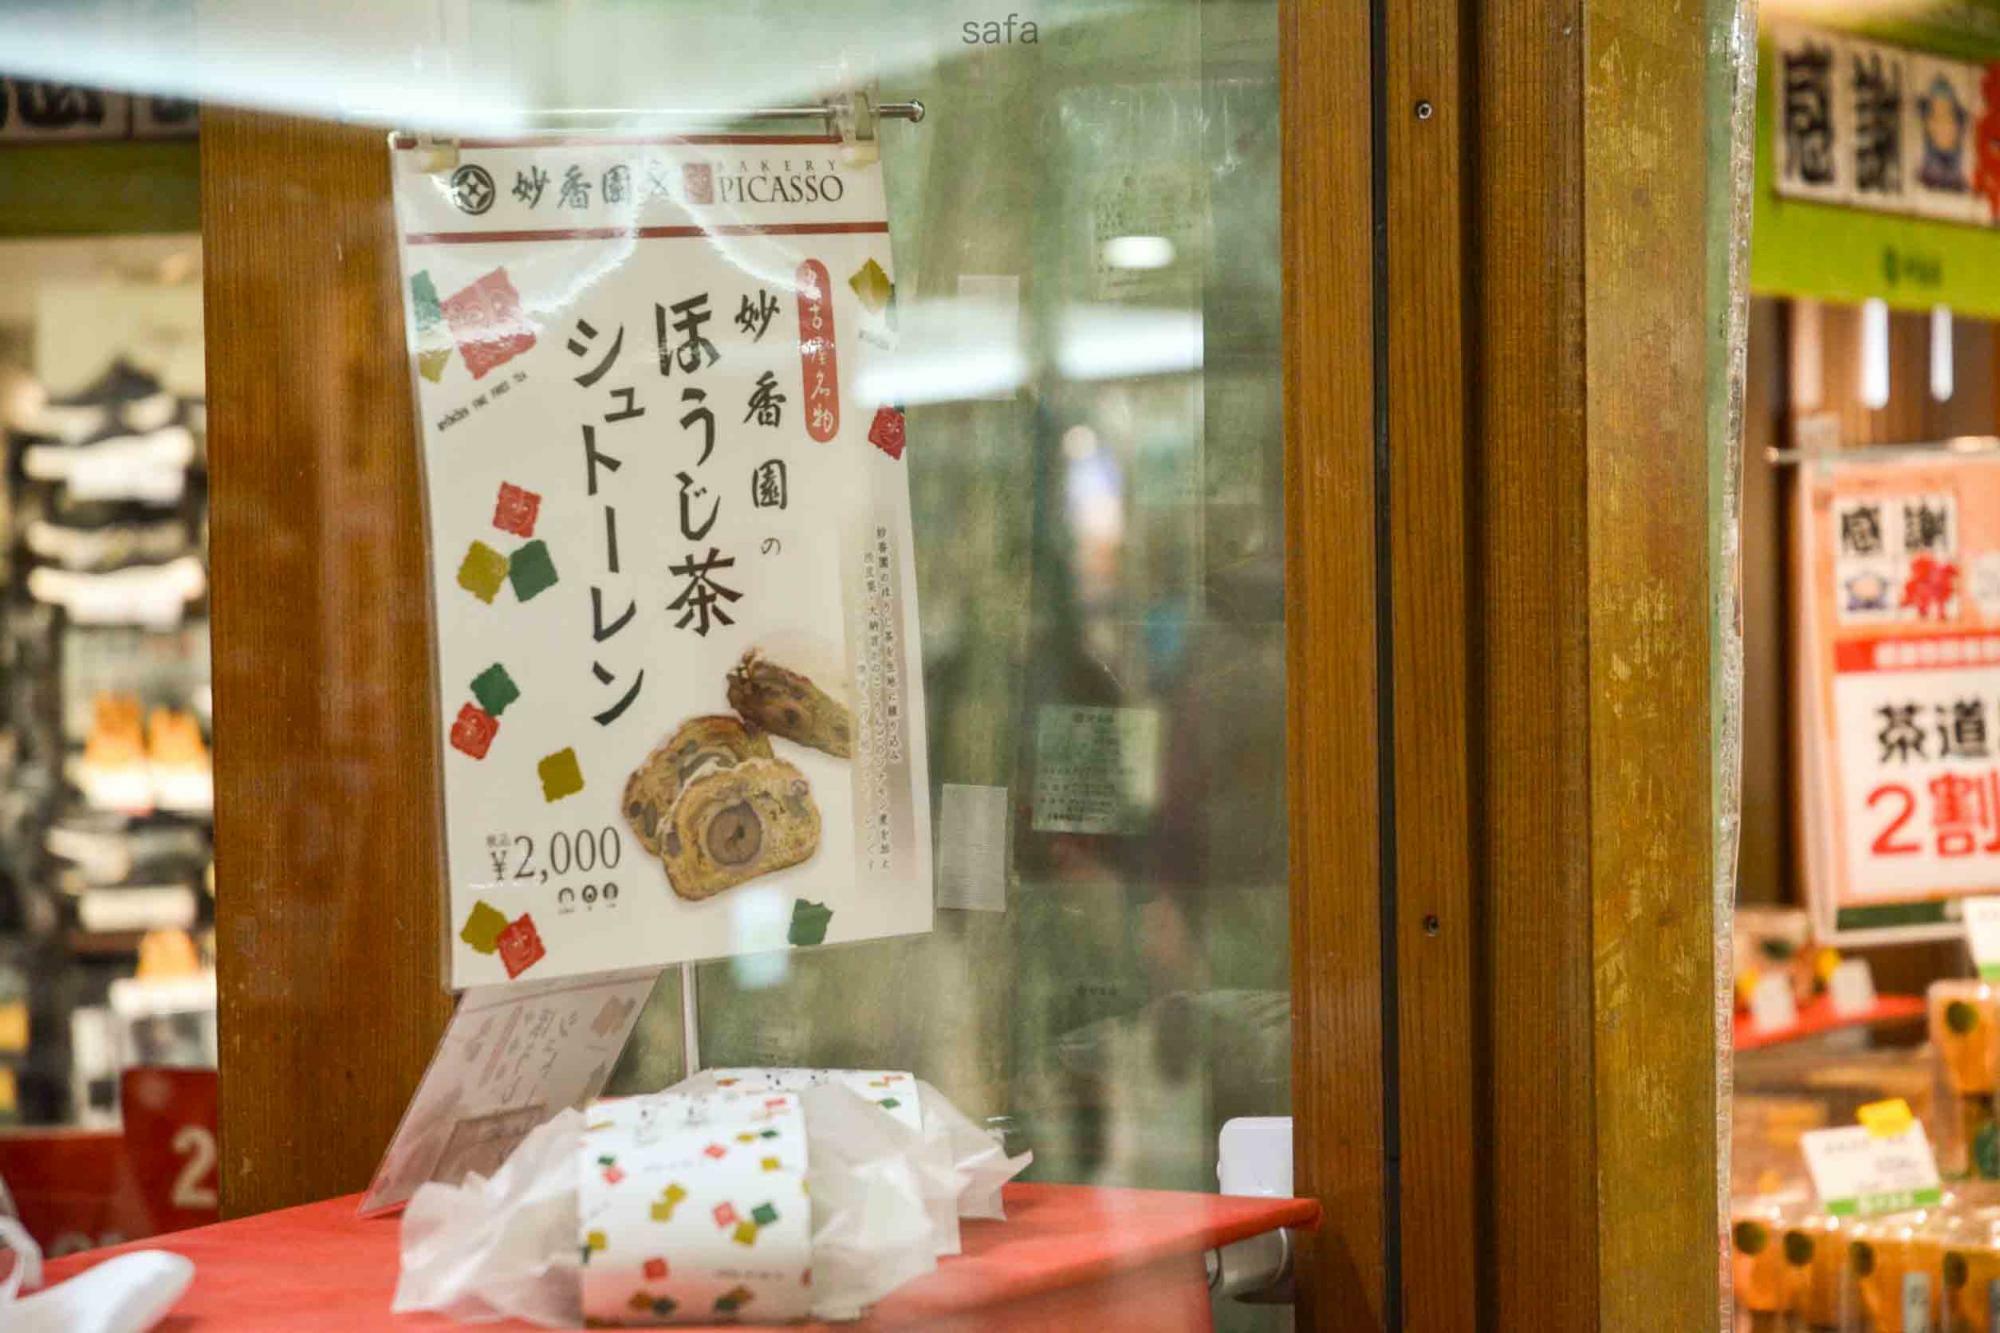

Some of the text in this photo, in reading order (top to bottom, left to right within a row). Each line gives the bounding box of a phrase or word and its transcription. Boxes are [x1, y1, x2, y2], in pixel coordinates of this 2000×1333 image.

[716, 160, 838, 173] AKERY
[718, 174, 845, 203] PICASSO
[801, 266, 835, 434] 古屋名物
[654, 291, 745, 638] ほうじ茶
[734, 288, 789, 557] 妙香園の
[566, 318, 646, 727] シュトーレン
[1876, 699, 2000, 763] 茶道
[490, 826, 621, 884] ¥2,000
